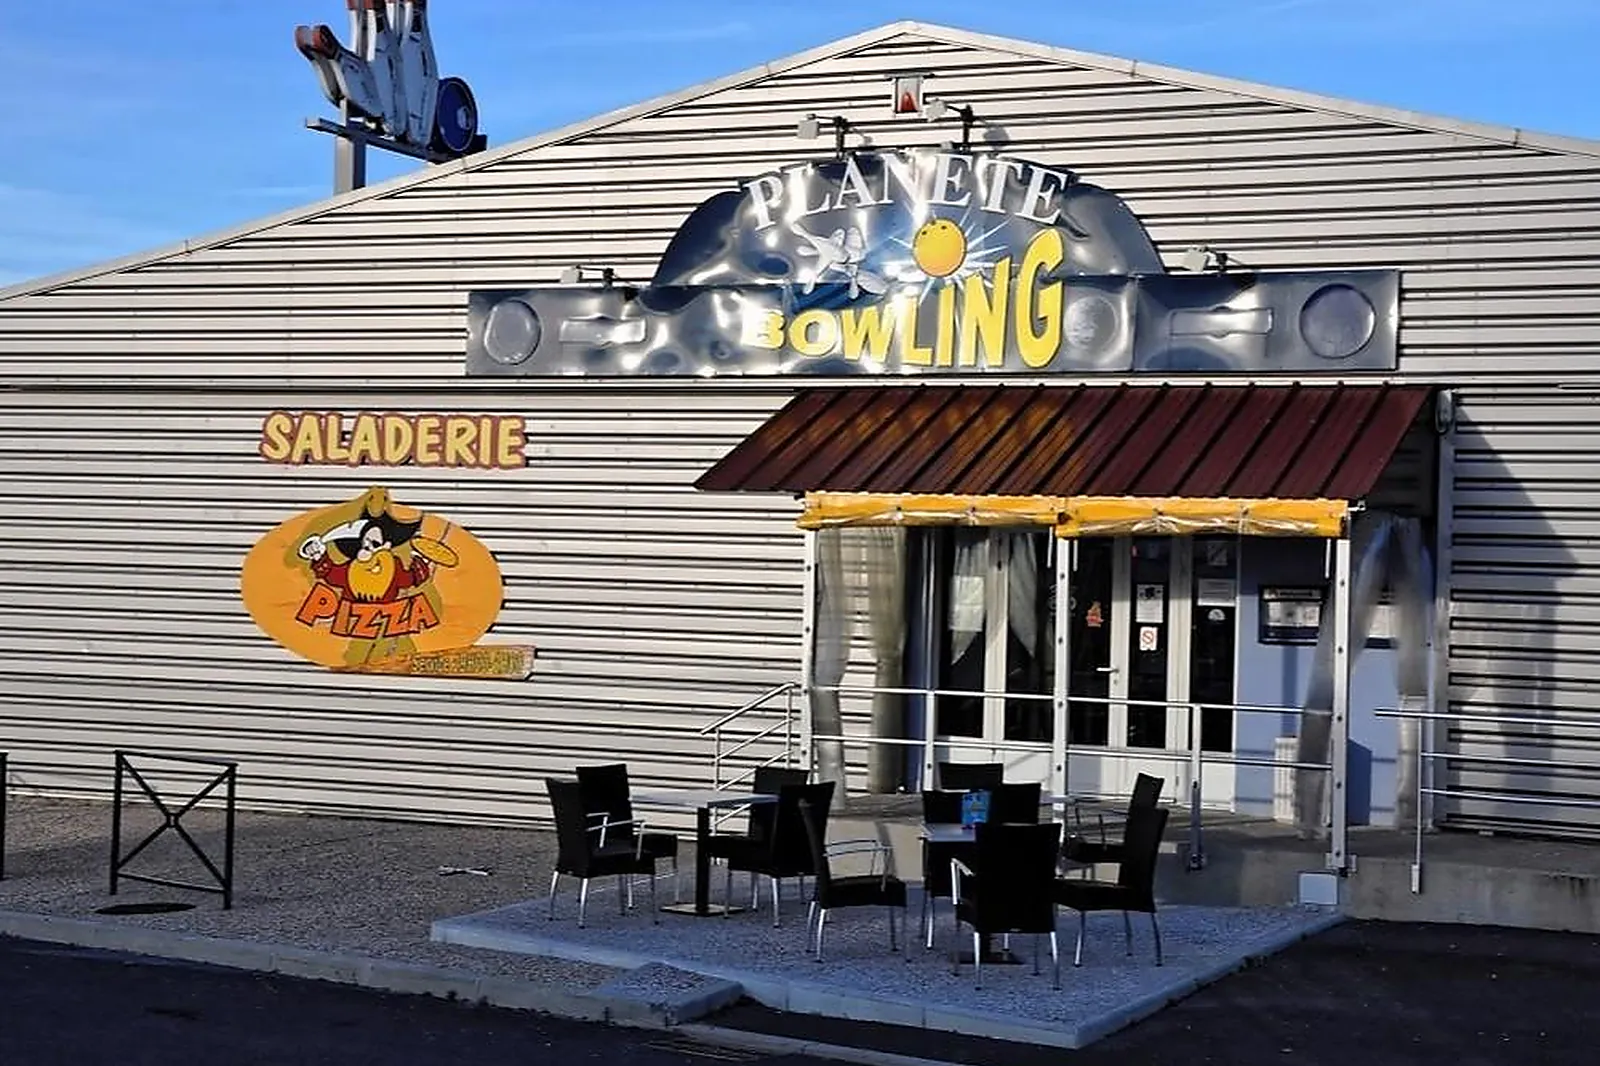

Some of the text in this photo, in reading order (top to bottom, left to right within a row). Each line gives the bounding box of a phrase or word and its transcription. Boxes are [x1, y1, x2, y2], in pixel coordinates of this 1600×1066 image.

[747, 153, 1068, 231] PLANETE
[741, 228, 1064, 368] BOWLING
[259, 411, 527, 468] SALADERIE
[296, 582, 440, 638] PIZZA
